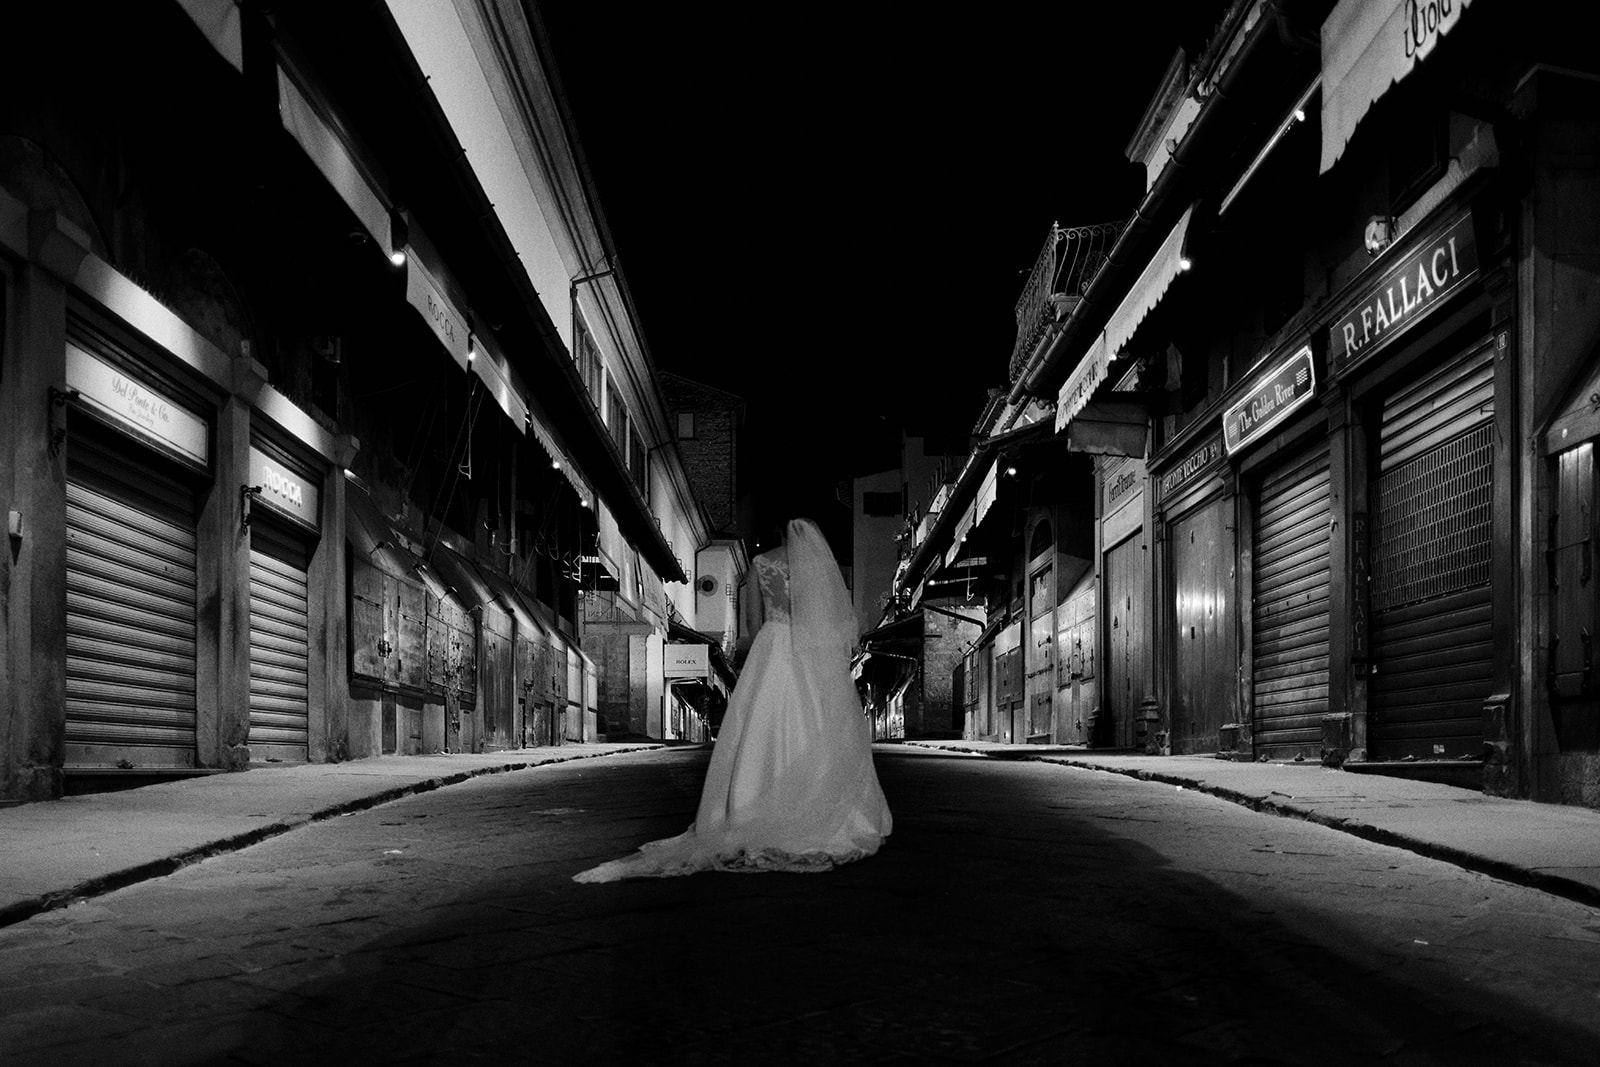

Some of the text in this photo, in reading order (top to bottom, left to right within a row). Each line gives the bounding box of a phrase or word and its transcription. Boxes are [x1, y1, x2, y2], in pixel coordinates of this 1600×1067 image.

[427, 295, 455, 342] ROCCA
[1342, 237, 1460, 358] R.FALLACI
[128, 386, 150, 411] Ponte
[1239, 383, 1295, 432] The Golden River
[1182, 447, 1208, 479] VECCHIO
[263, 466, 303, 508] ROCCA
